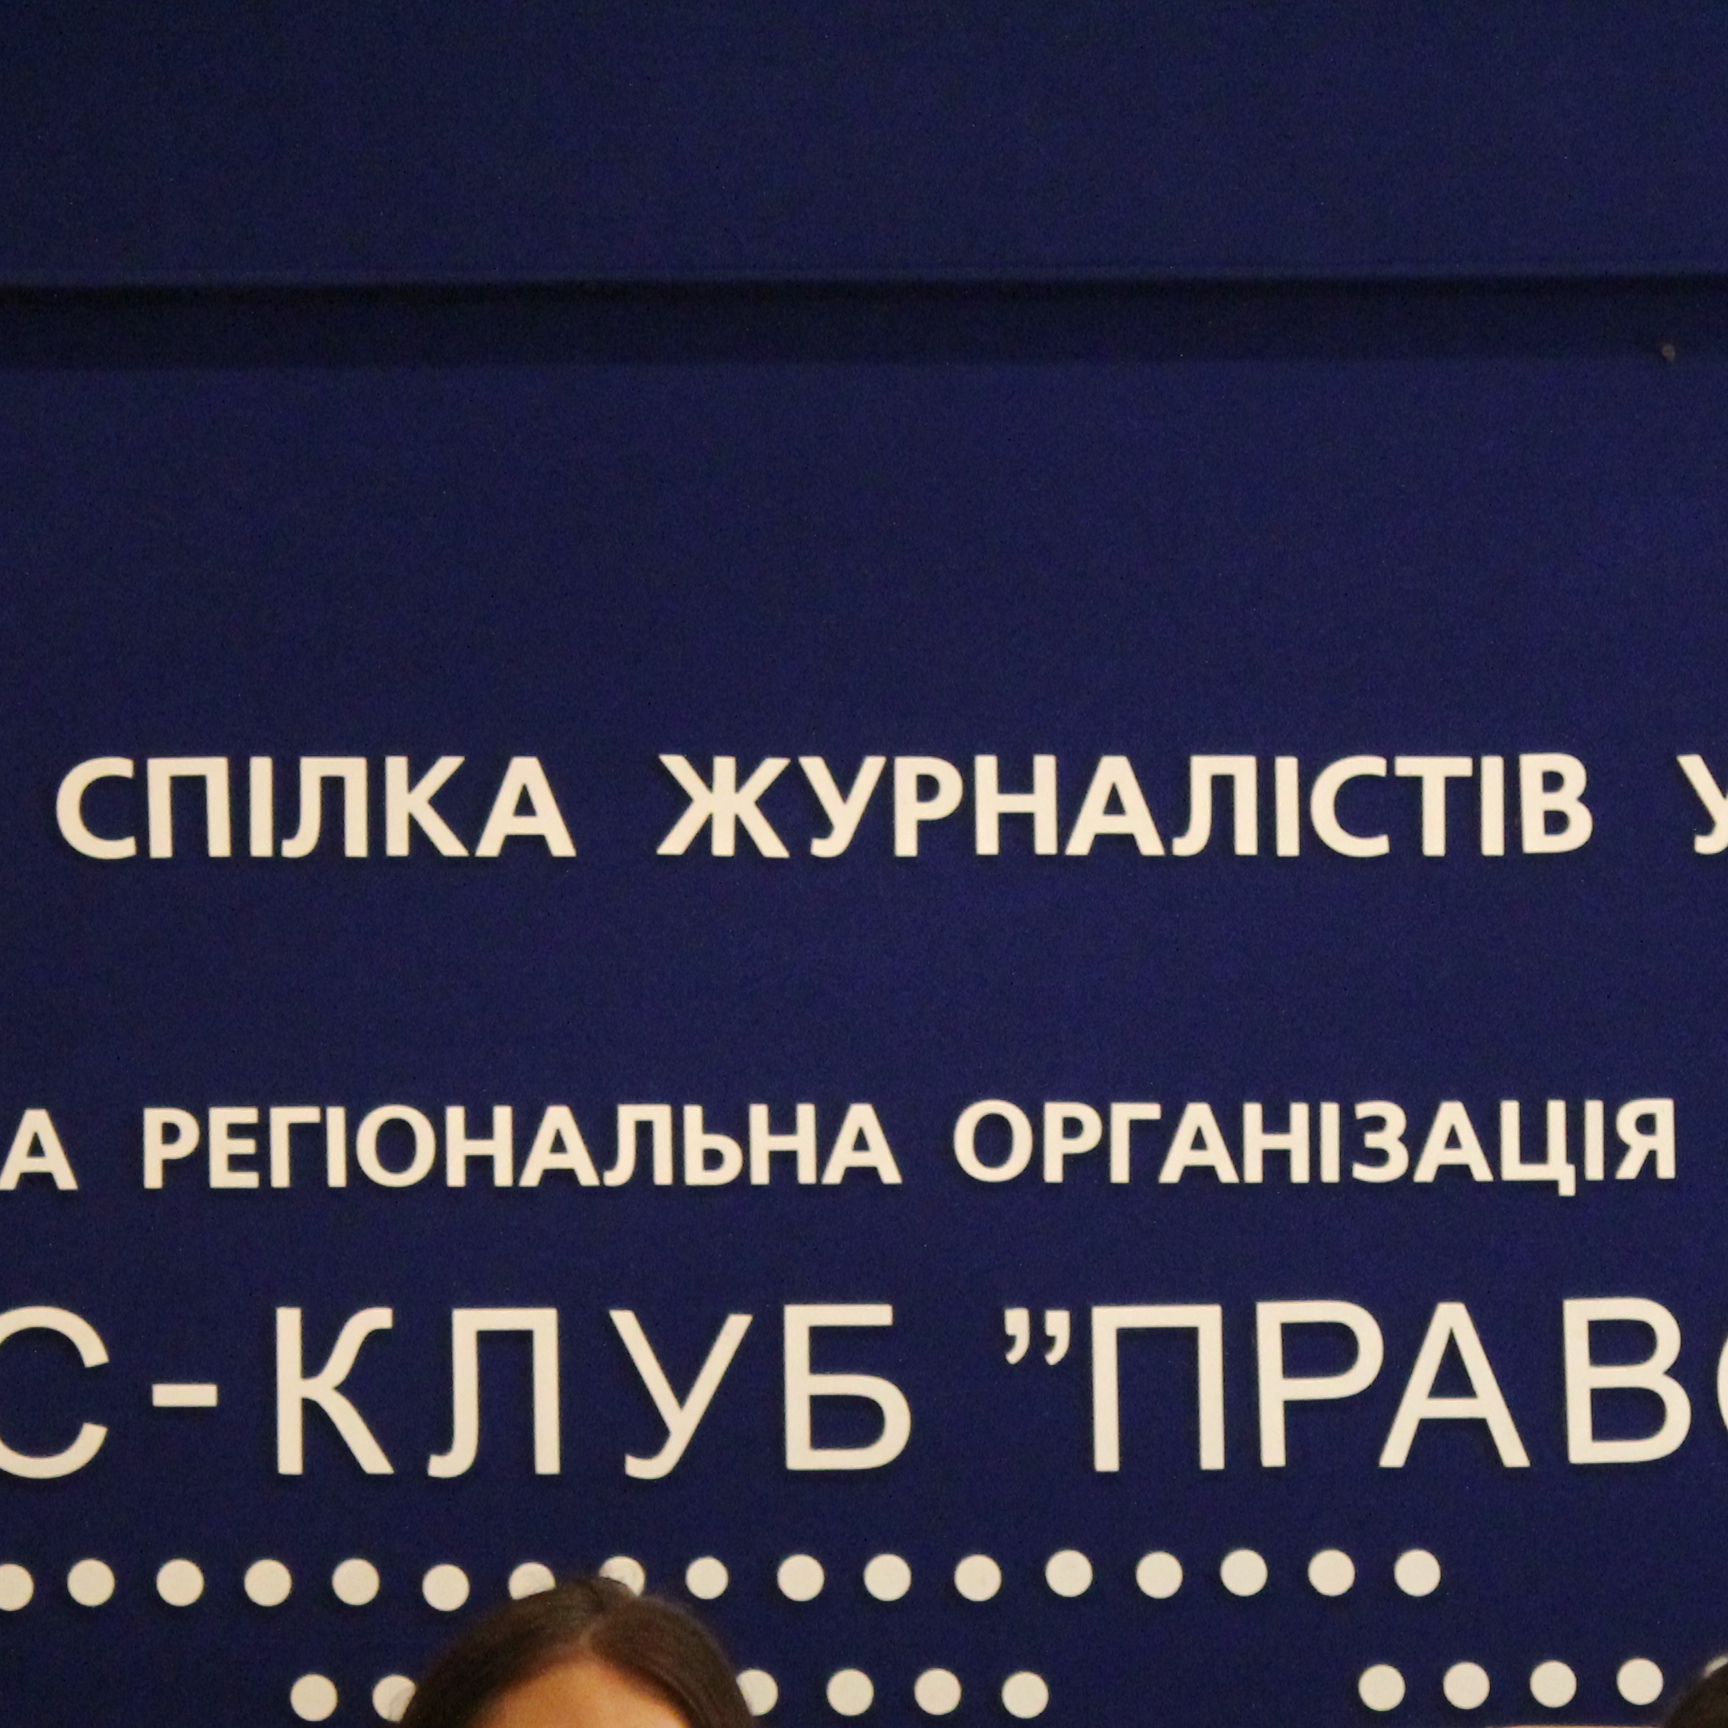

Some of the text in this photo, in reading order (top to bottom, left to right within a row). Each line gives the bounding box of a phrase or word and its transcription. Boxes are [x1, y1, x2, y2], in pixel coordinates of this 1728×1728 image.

[55, 755, 576, 860] СПІЛКА
[656, 752, 1594, 858] ЖУРНАЛІСТІВ
[142, 1102, 903, 1190] РЕГІОНАЛЬНА
[952, 1097, 1677, 1198] ОРГАНІЗАЦІЯ
